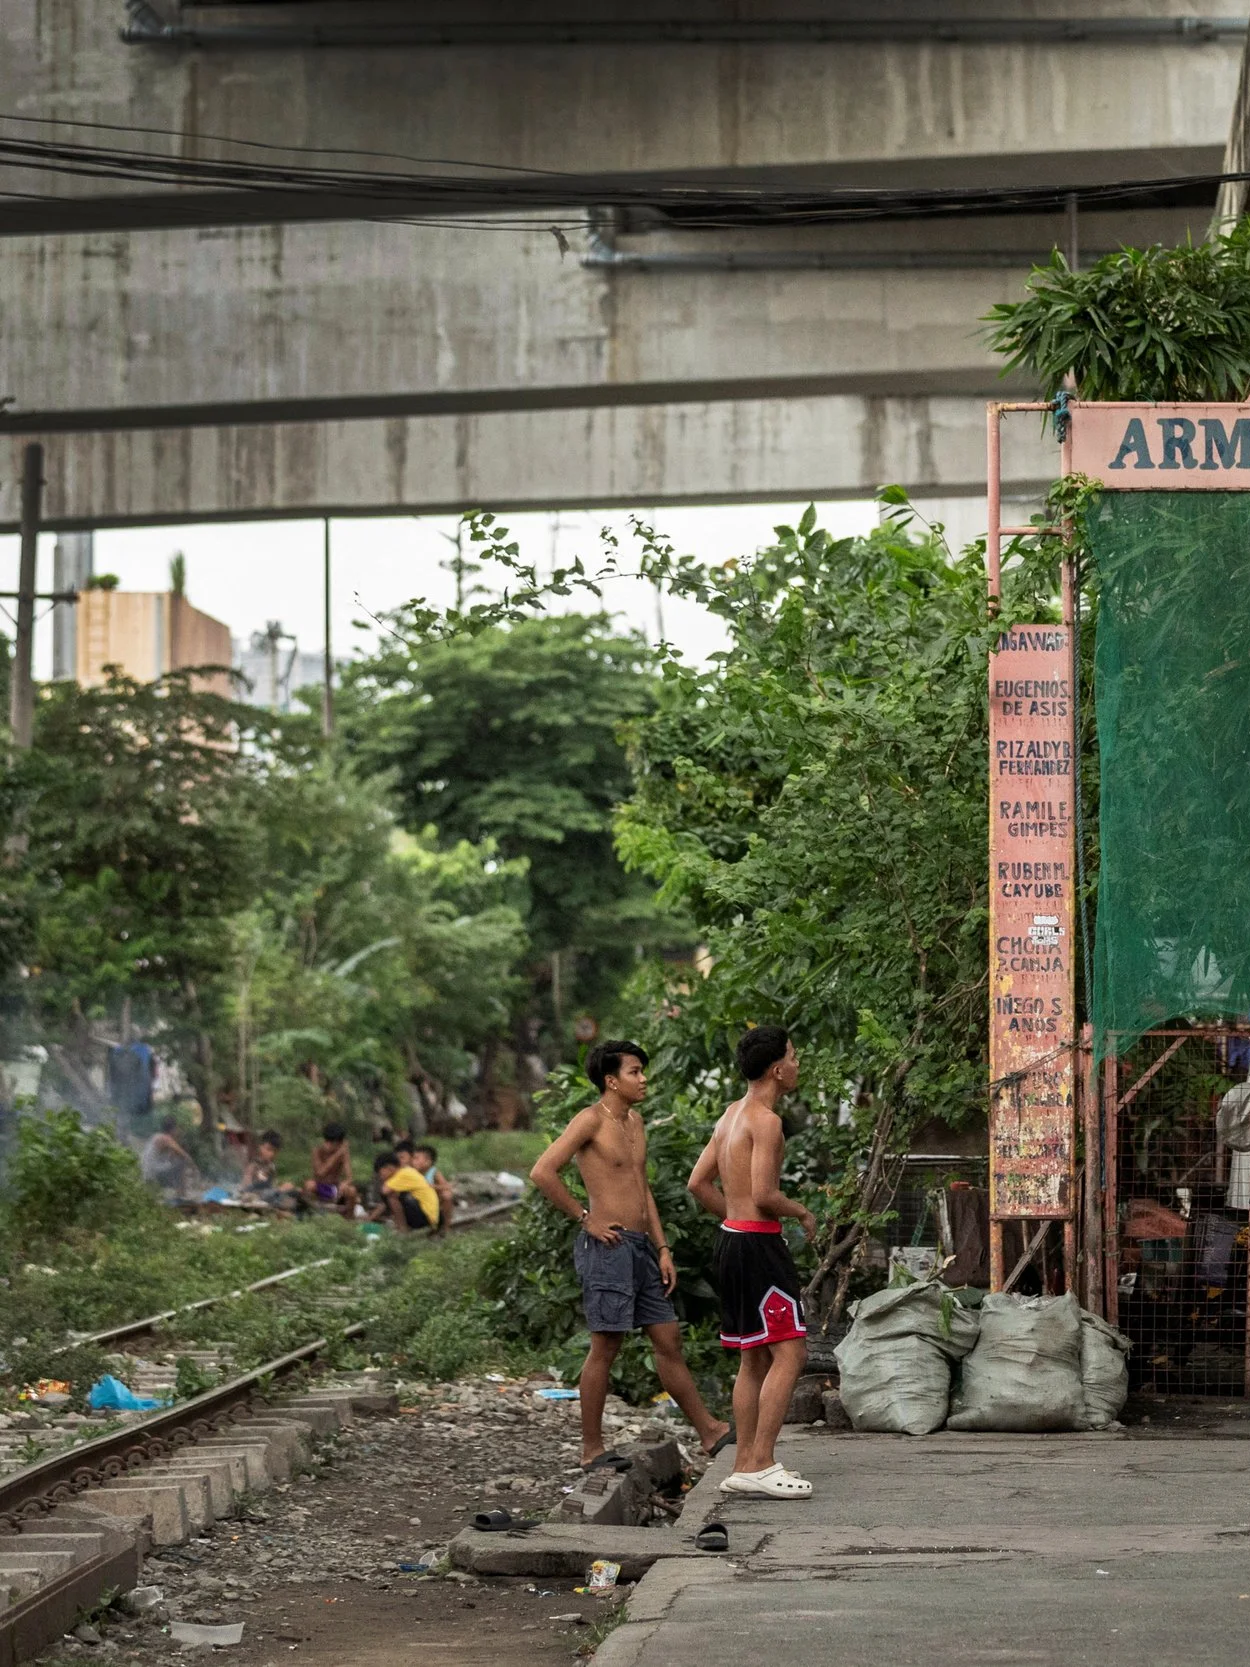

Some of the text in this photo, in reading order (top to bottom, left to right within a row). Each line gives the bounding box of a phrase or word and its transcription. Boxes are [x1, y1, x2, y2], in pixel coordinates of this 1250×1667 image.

[1002, 700, 1068, 716] DE ASIS
[999, 760, 1071, 776] FERNANDEZ
[1007, 822, 1068, 838] GIMPES
[1001, 883, 1064, 898] CAYUBE
